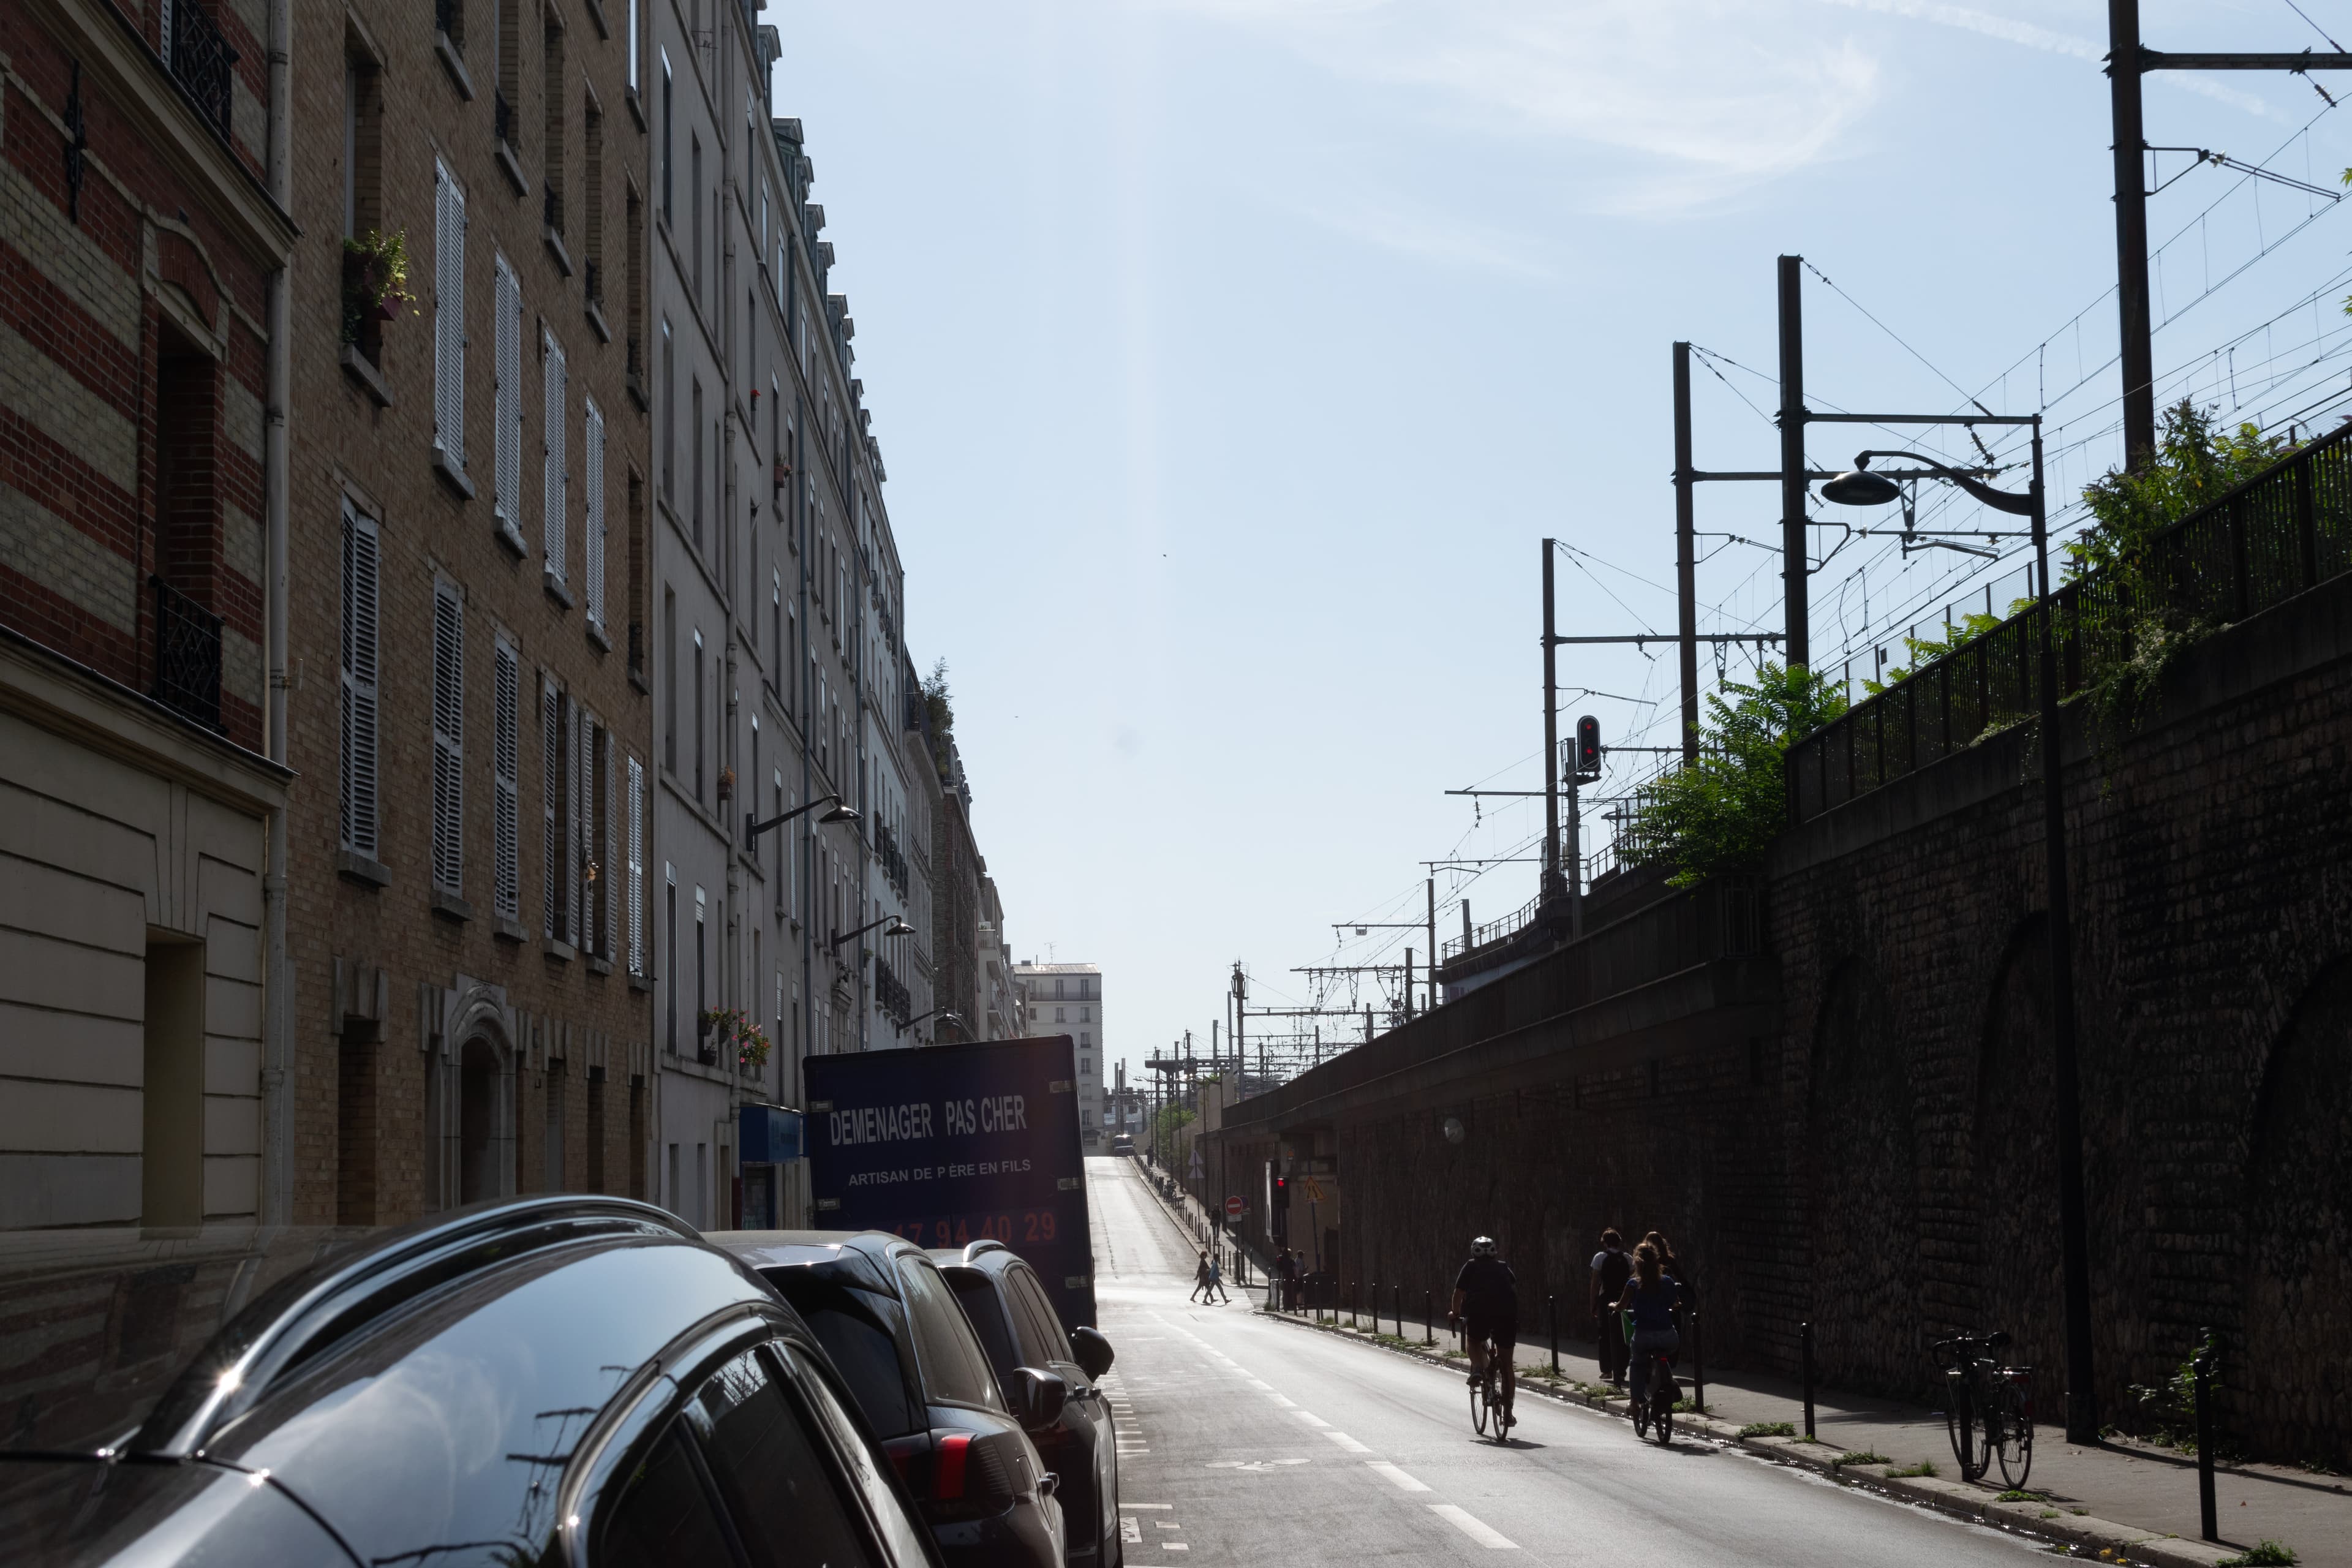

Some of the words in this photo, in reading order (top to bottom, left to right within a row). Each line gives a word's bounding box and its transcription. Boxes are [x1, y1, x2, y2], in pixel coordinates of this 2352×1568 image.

[830, 1103, 933, 1146] DEMENAGER
[946, 1098, 976, 1136] PAS
[981, 1095, 1027, 1133] CHER
[848, 1169, 908, 1186] ARTISAN
[914, 1167, 932, 1180] DE
[979, 1162, 997, 1175] EN
[1001, 1159, 1031, 1173] FILS
[936, 1217, 970, 1249] 94
[980, 1215, 1011, 1243] 40
[1024, 1212, 1056, 1242] 29
